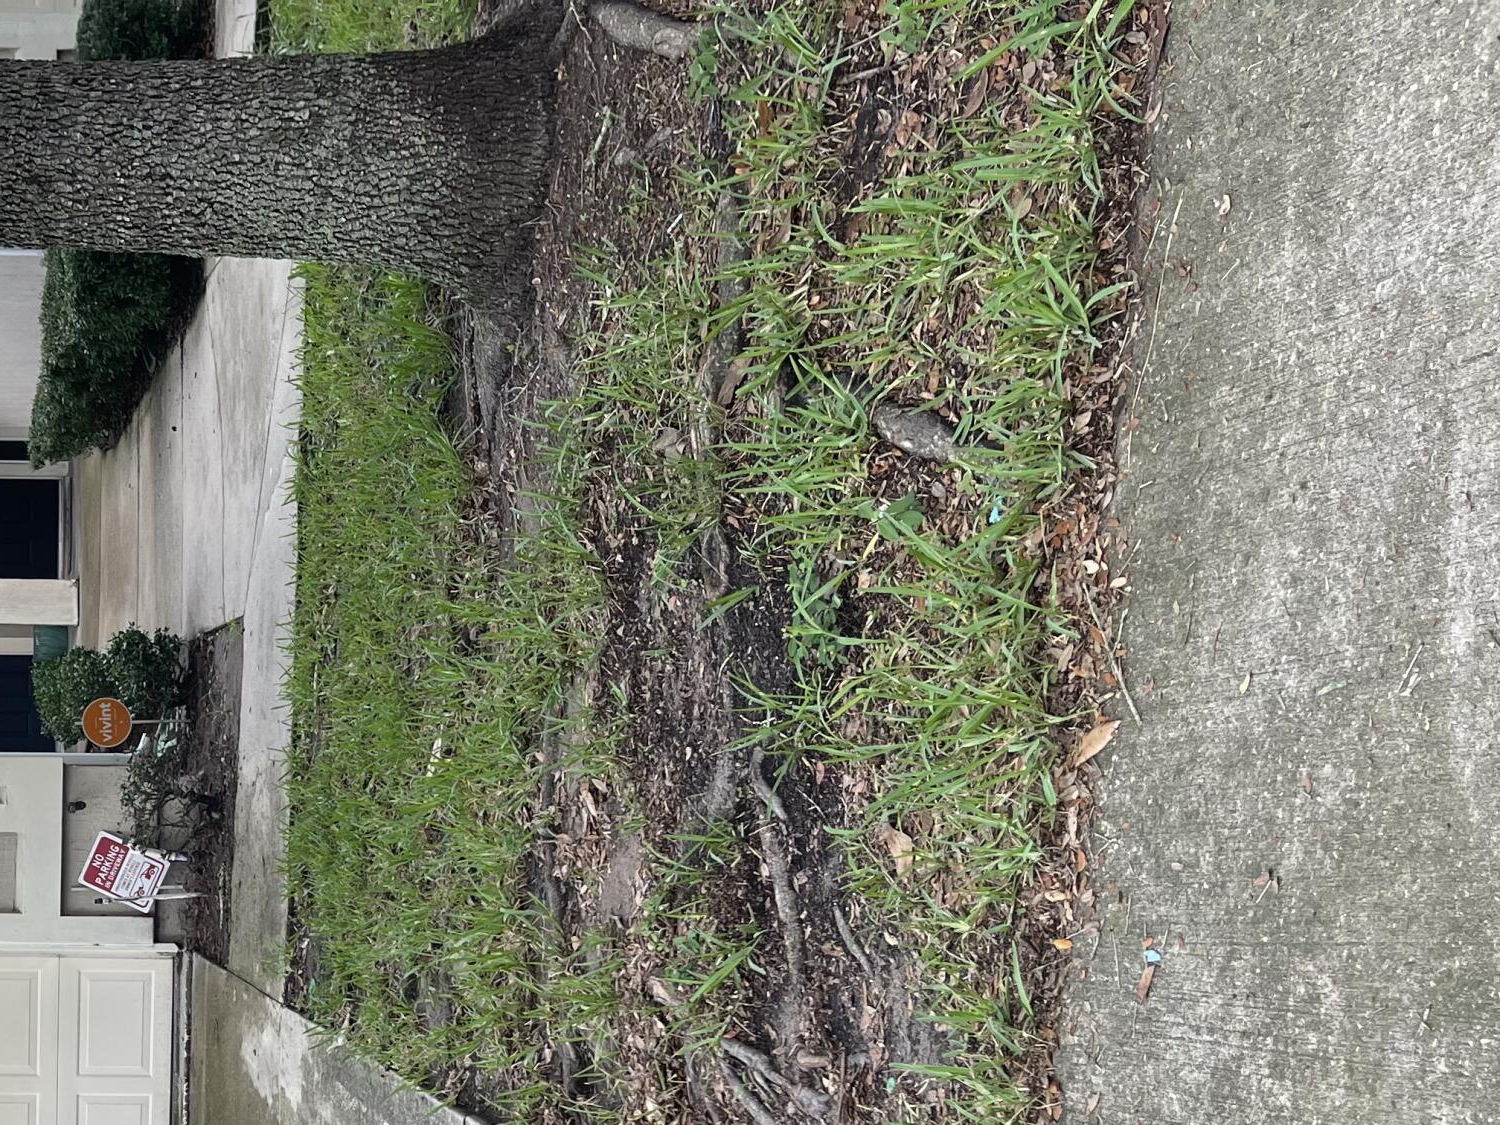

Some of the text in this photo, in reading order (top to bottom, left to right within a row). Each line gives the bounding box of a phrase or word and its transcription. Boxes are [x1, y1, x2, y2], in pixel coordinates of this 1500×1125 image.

[99, 703, 112, 742] vivint
[92, 854, 104, 868] NO
[95, 845, 120, 885] PARKING
[108, 849, 125, 880] DRIVEWAY
